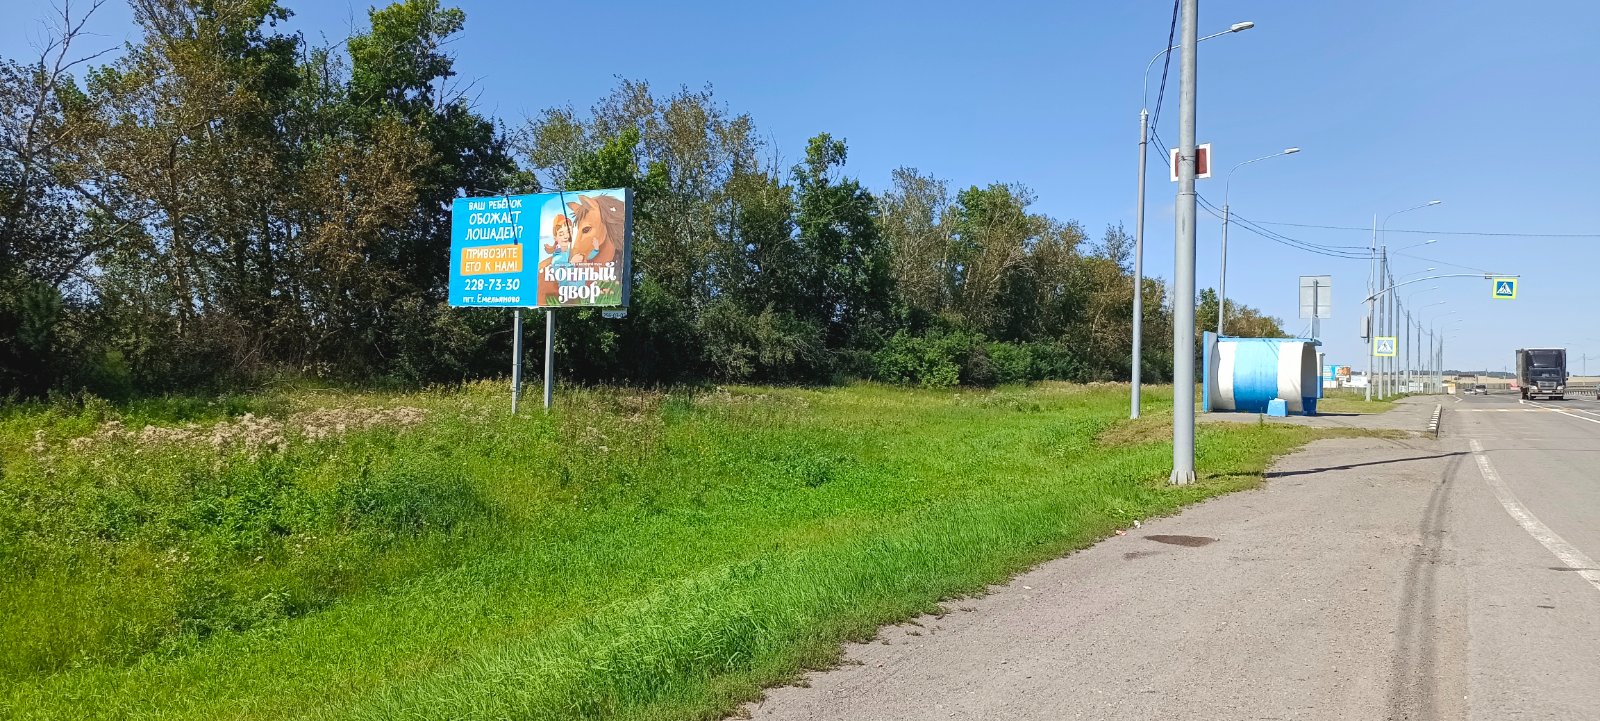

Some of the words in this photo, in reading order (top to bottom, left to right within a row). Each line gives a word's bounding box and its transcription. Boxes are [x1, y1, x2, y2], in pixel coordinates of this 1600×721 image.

[468, 201, 486, 211] ВАШ
[488, 197, 523, 210] РЕБЁНОК
[469, 210, 522, 225] ОБОЖАЕТ
[465, 224, 524, 241] ЛОШАДЕЙ?
[466, 247, 518, 260] ПРИВОЗИТЕ
[485, 260, 491, 272] К
[494, 260, 518, 272] НАМ!
[464, 278, 520, 291] 228-73-30
[477, 293, 521, 303] Емельяново
